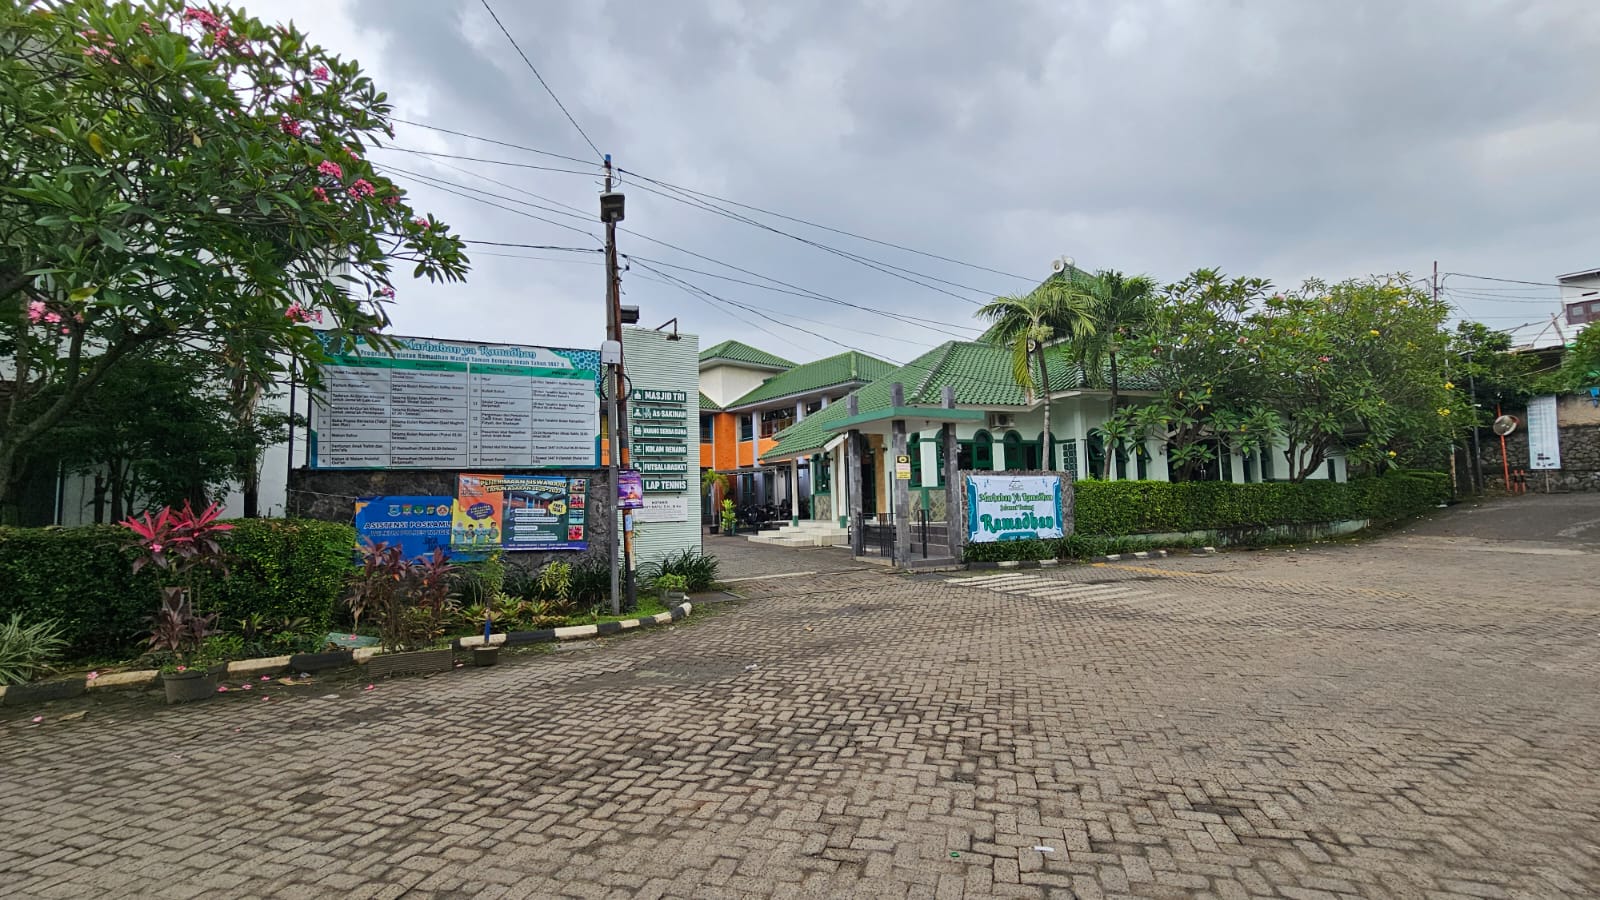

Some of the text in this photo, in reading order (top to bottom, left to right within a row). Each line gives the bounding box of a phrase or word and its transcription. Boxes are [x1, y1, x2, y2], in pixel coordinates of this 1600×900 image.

[401, 338, 536, 359] Marhaban ya Ramadhan
[644, 391, 685, 401] MASJID TRI
[646, 480, 686, 490] LAP TENNIS
[980, 512, 1054, 534] Ramadhan
